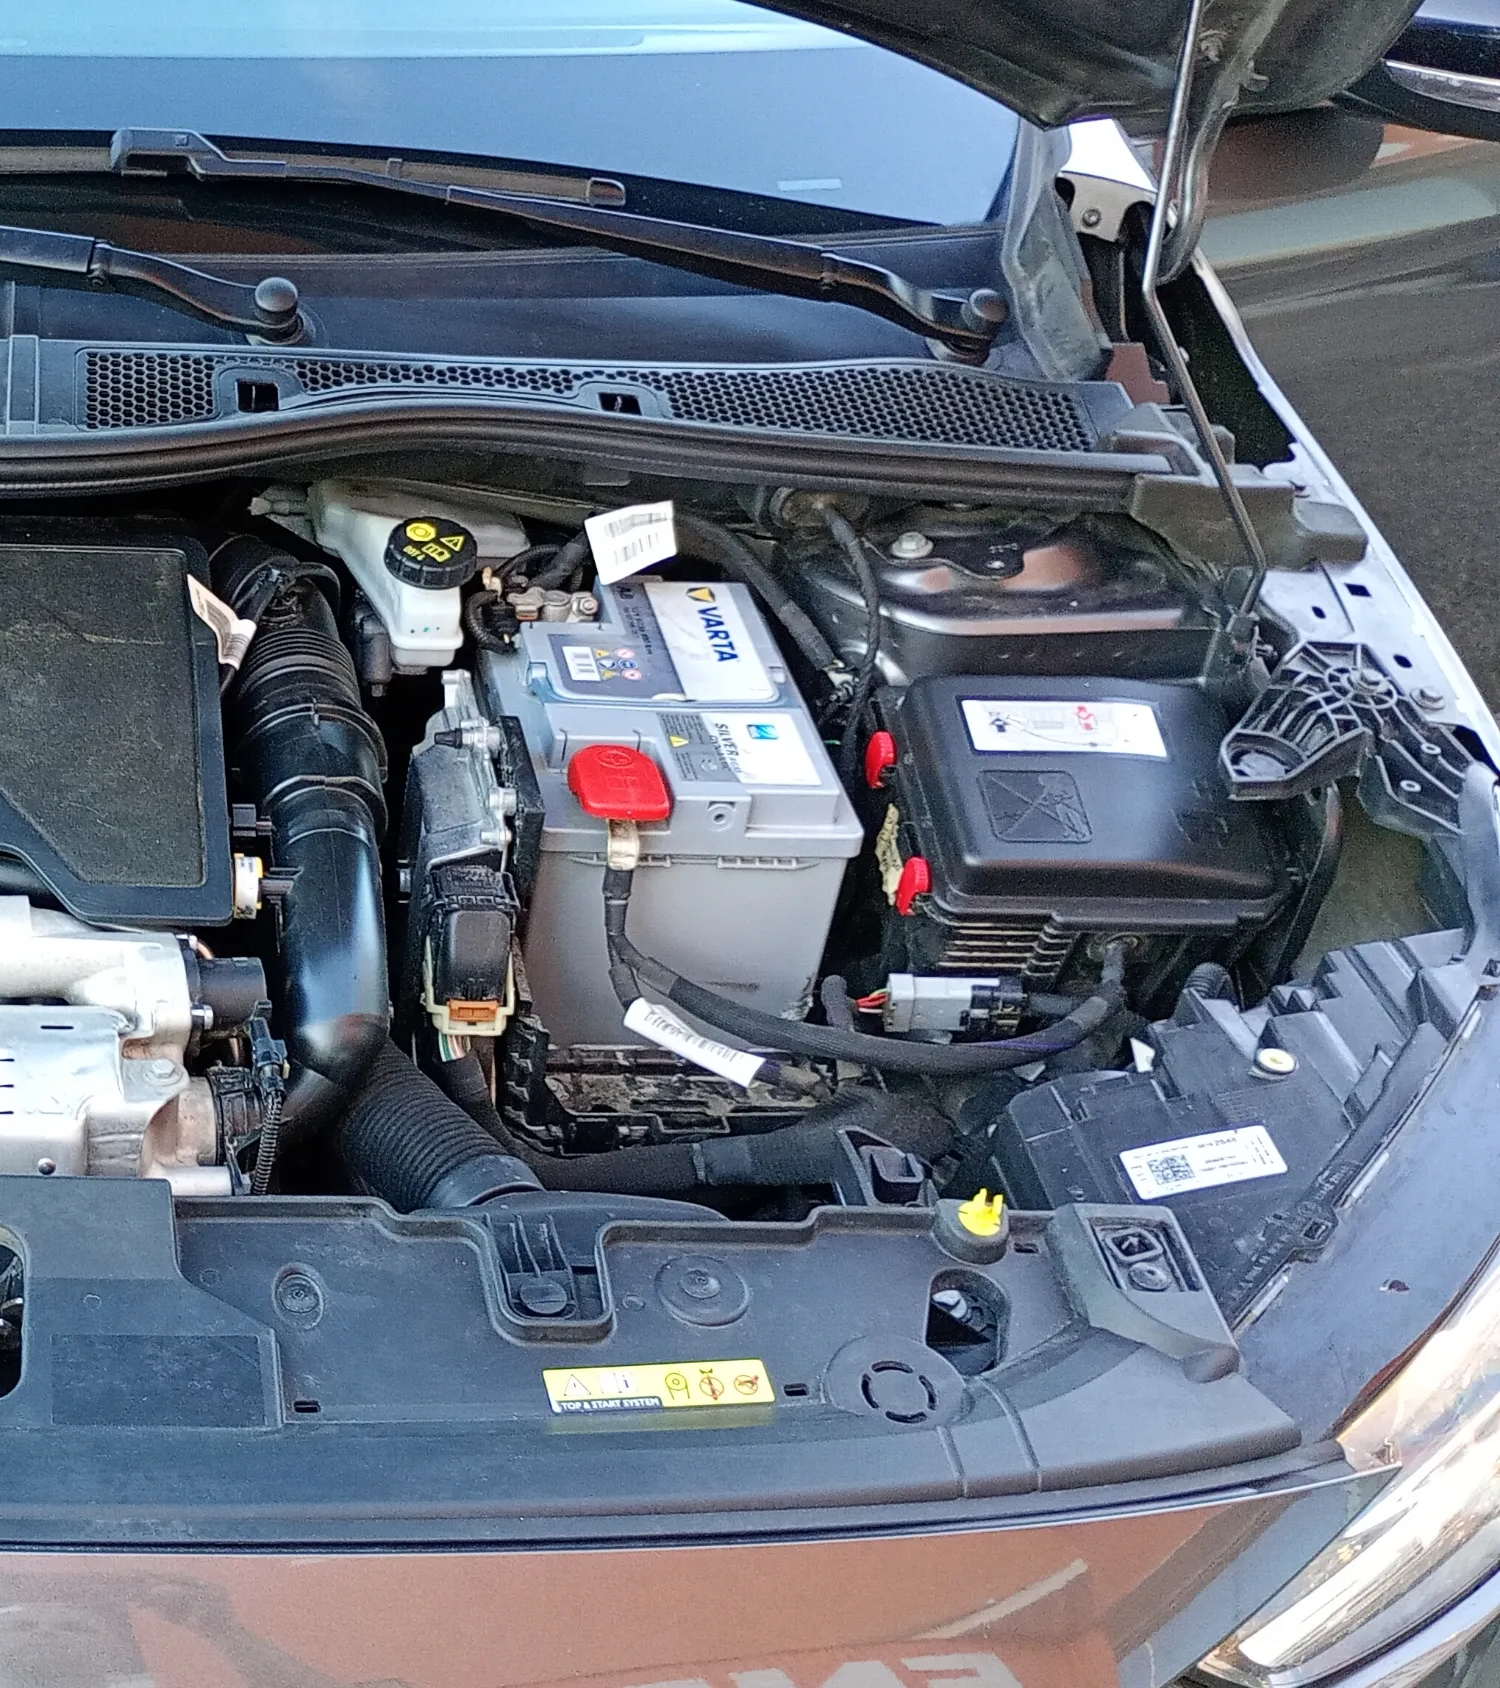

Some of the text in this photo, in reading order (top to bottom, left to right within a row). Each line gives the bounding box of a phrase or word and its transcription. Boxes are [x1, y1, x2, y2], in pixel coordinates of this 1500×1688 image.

[697, 606, 739, 663] VARTA
[715, 723, 740, 757] SILVER
[592, 1399, 622, 1409] START
[622, 1397, 660, 1408] SYSTEM
